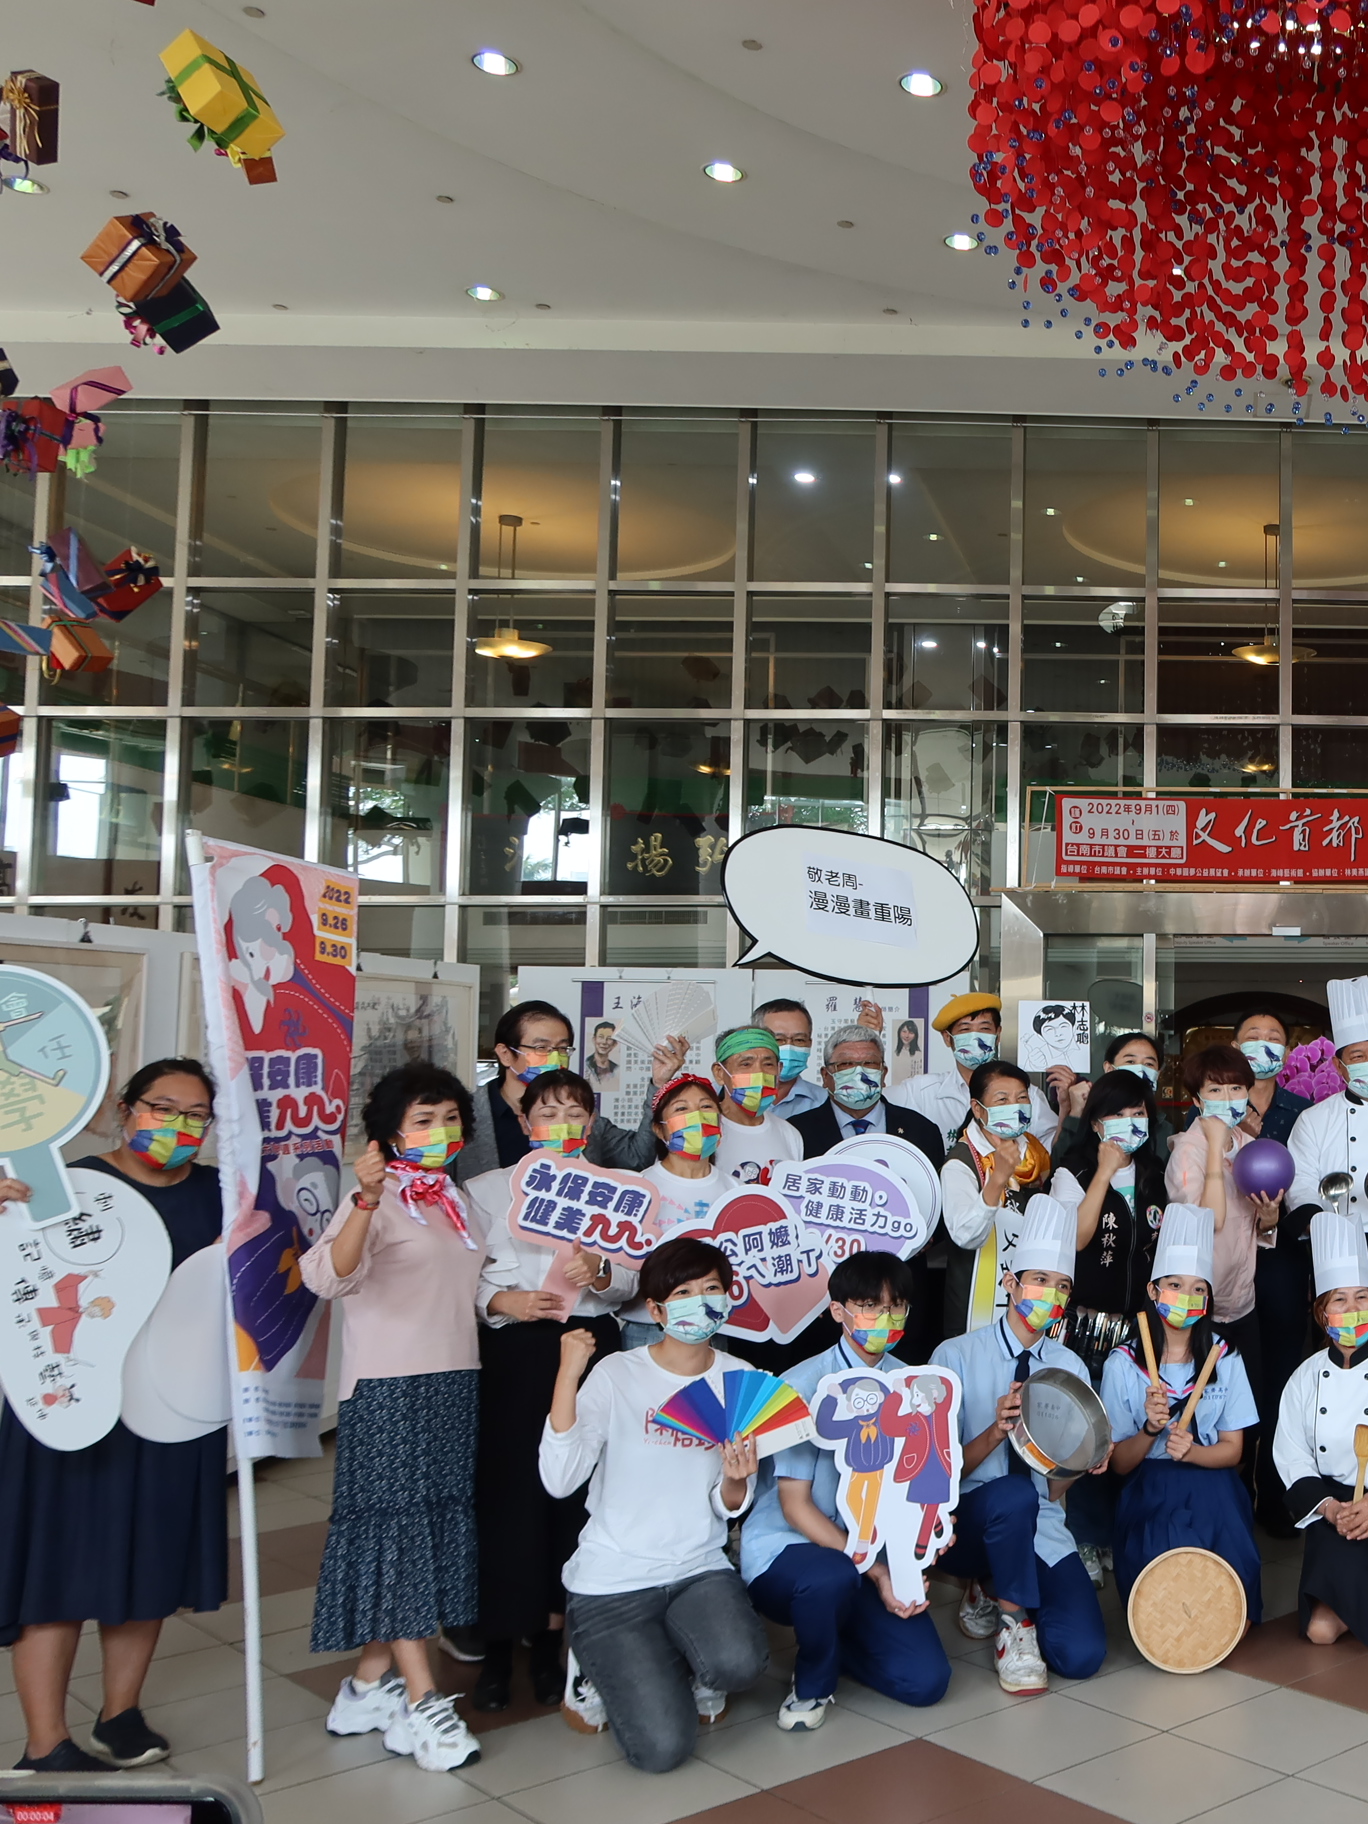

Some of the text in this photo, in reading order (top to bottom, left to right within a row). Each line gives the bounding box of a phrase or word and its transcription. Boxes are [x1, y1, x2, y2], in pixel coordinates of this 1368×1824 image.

[320, 912, 348, 931] 9.26
[808, 890, 913, 927] 漫漫畫重陽
[318, 941, 347, 959] 9.30
[1070, 1002, 1089, 1045] 林志聰
[525, 1163, 646, 1217] 永保安康
[782, 1174, 886, 1203] 居家動動，
[804, 1200, 914, 1235] 健康活力go
[1100, 1212, 1119, 1268] 陳秋萍
